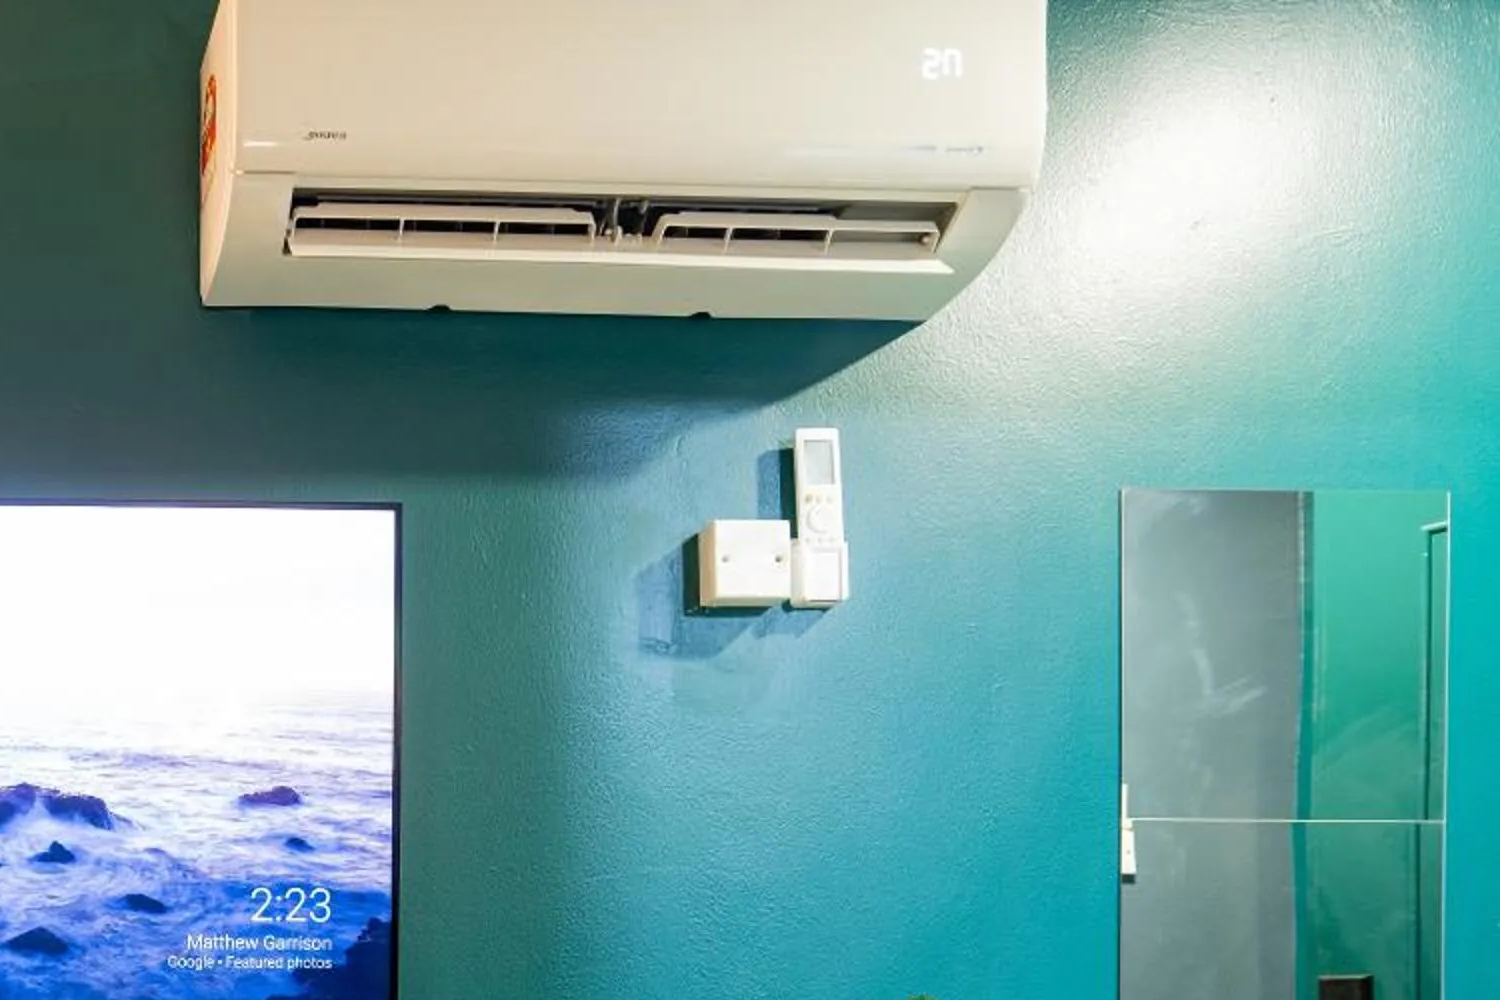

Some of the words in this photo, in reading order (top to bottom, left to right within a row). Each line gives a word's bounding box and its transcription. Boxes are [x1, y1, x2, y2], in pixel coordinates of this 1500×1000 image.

[250, 887, 332, 923] 2:23
[187, 934, 258, 951] Matthew
[263, 935, 333, 951] Garrison
[167, 955, 214, 971] Google
[226, 955, 284, 969] Featured
[287, 955, 333, 972] photos
